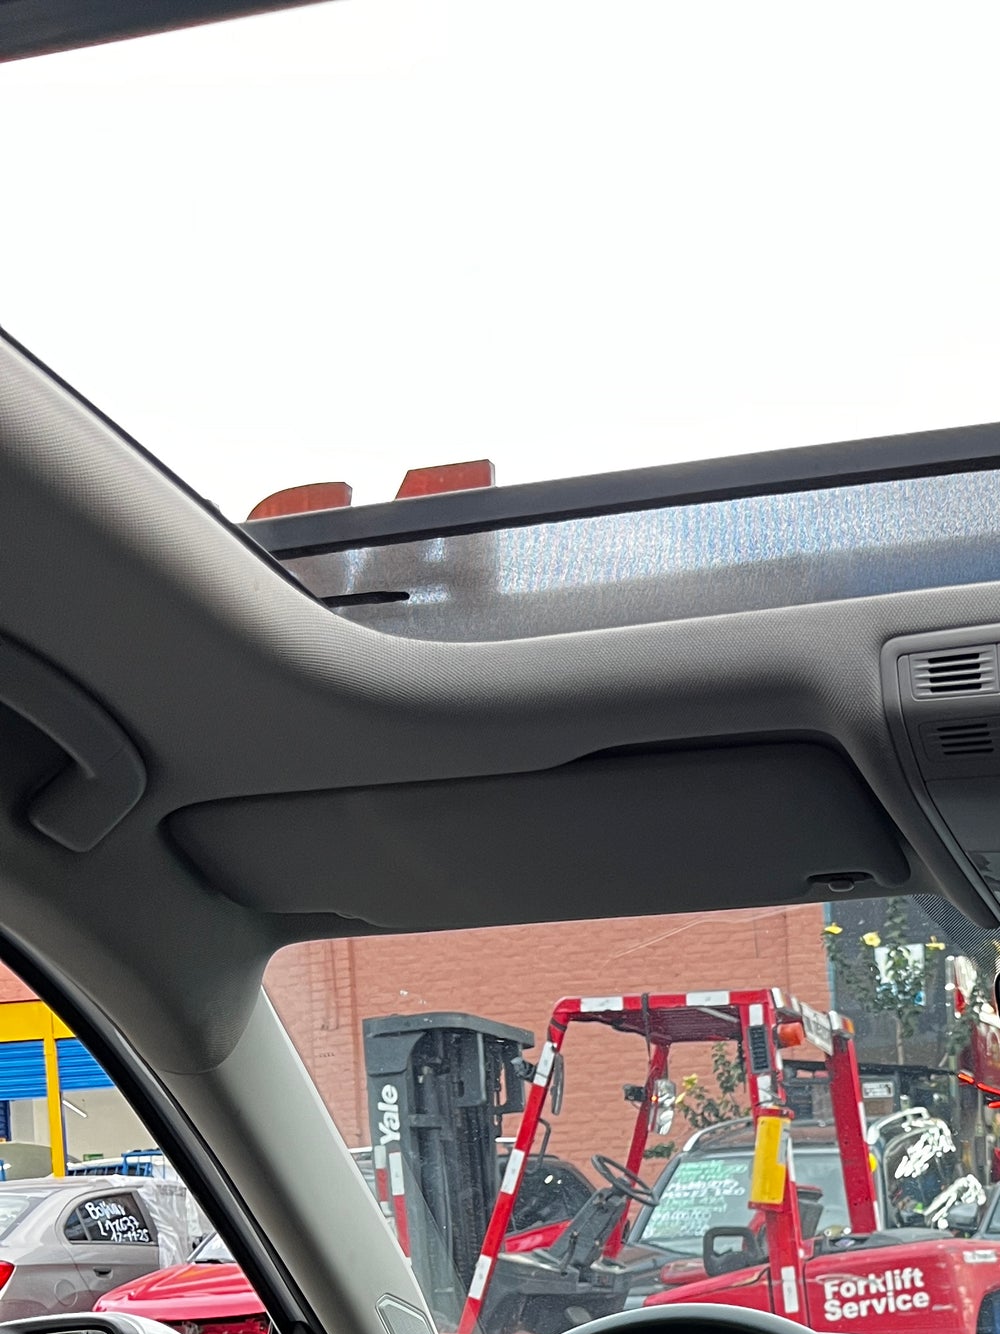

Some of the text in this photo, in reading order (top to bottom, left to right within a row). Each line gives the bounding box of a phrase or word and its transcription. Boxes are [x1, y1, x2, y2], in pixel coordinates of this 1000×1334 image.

[377, 1084, 400, 1145] Yale
[824, 1267, 925, 1300] Forklift
[824, 1292, 930, 1321] Service
